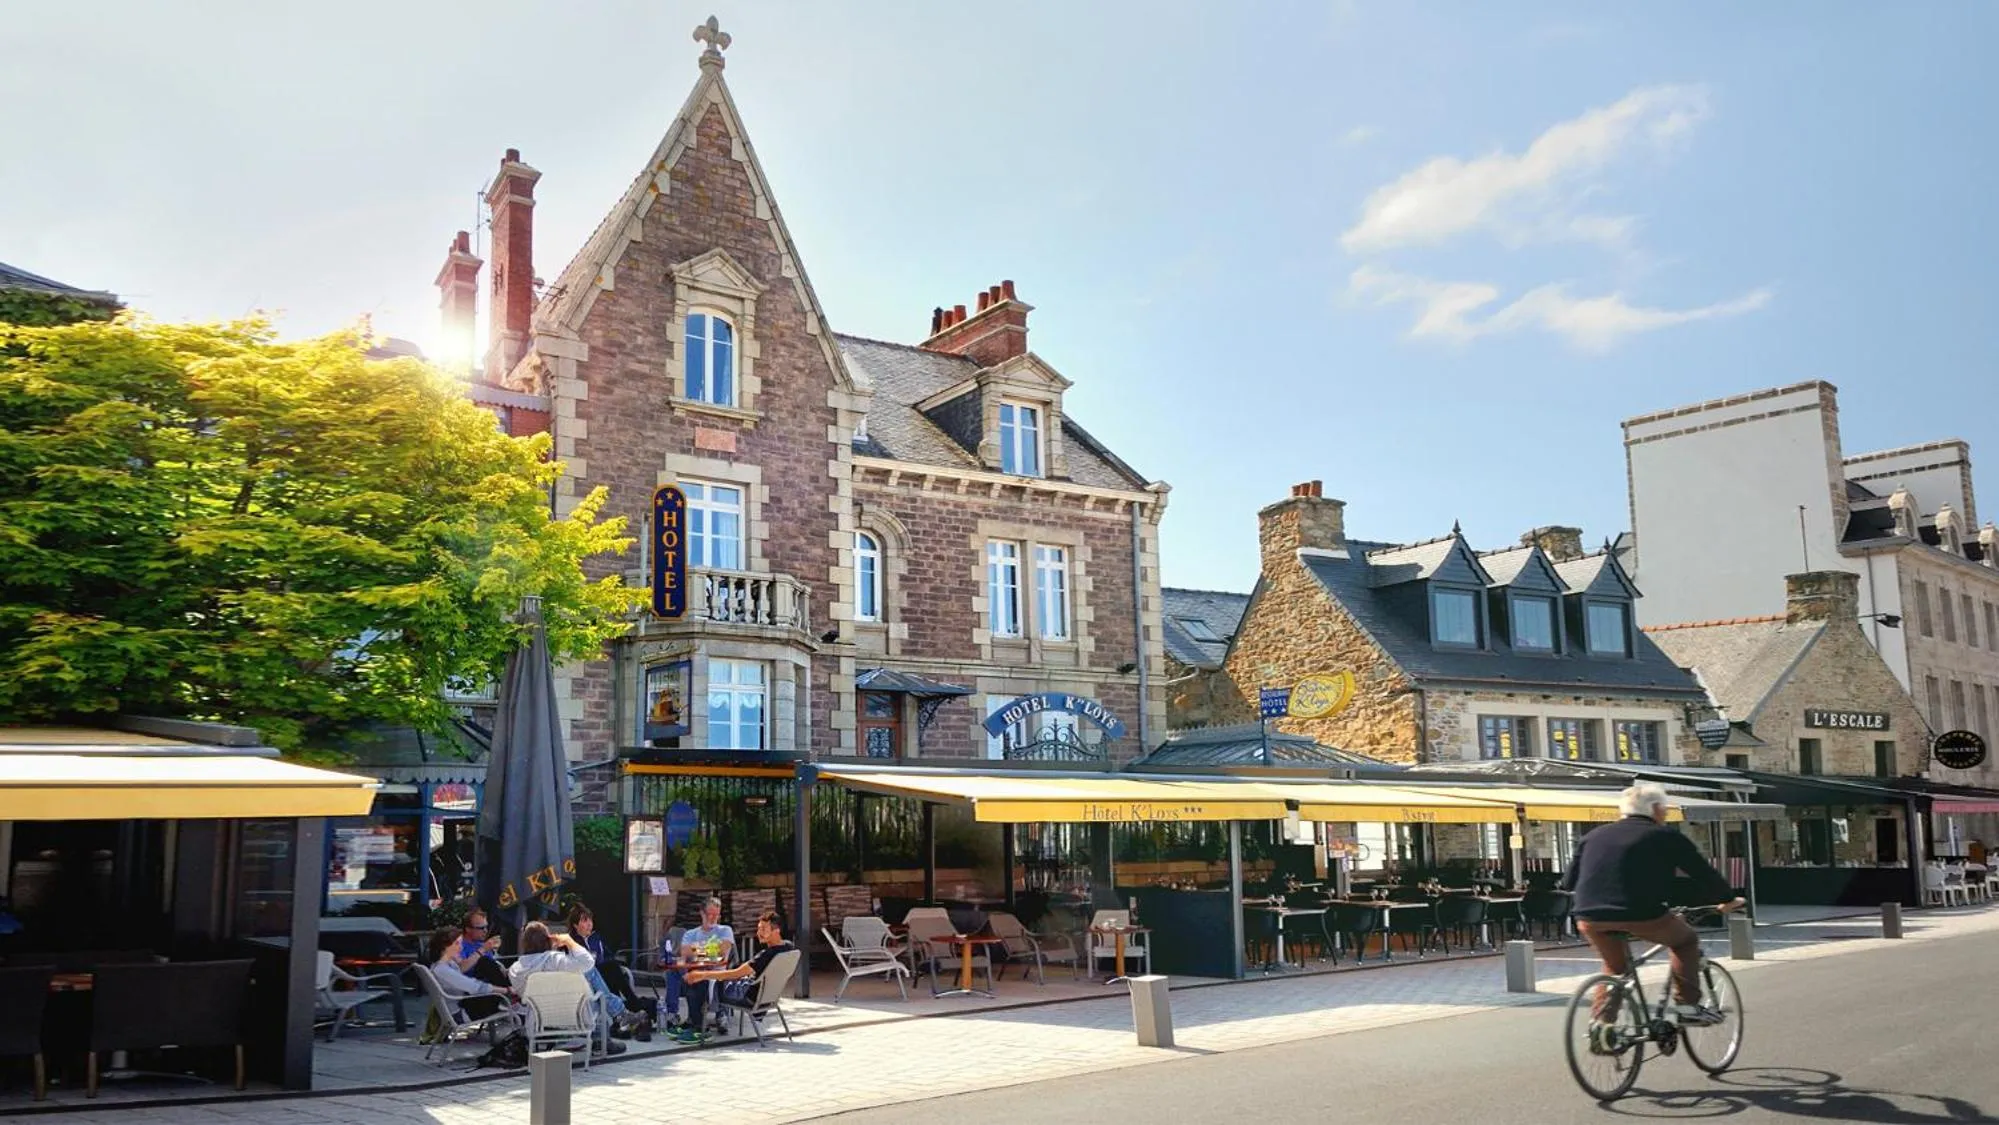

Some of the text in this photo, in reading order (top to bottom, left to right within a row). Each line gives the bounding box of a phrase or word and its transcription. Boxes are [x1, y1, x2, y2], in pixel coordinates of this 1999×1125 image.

[662, 511, 678, 610] HOTEL
[1002, 696, 1051, 726] HOTEL
[1814, 712, 1884, 729] L'ESCALE
